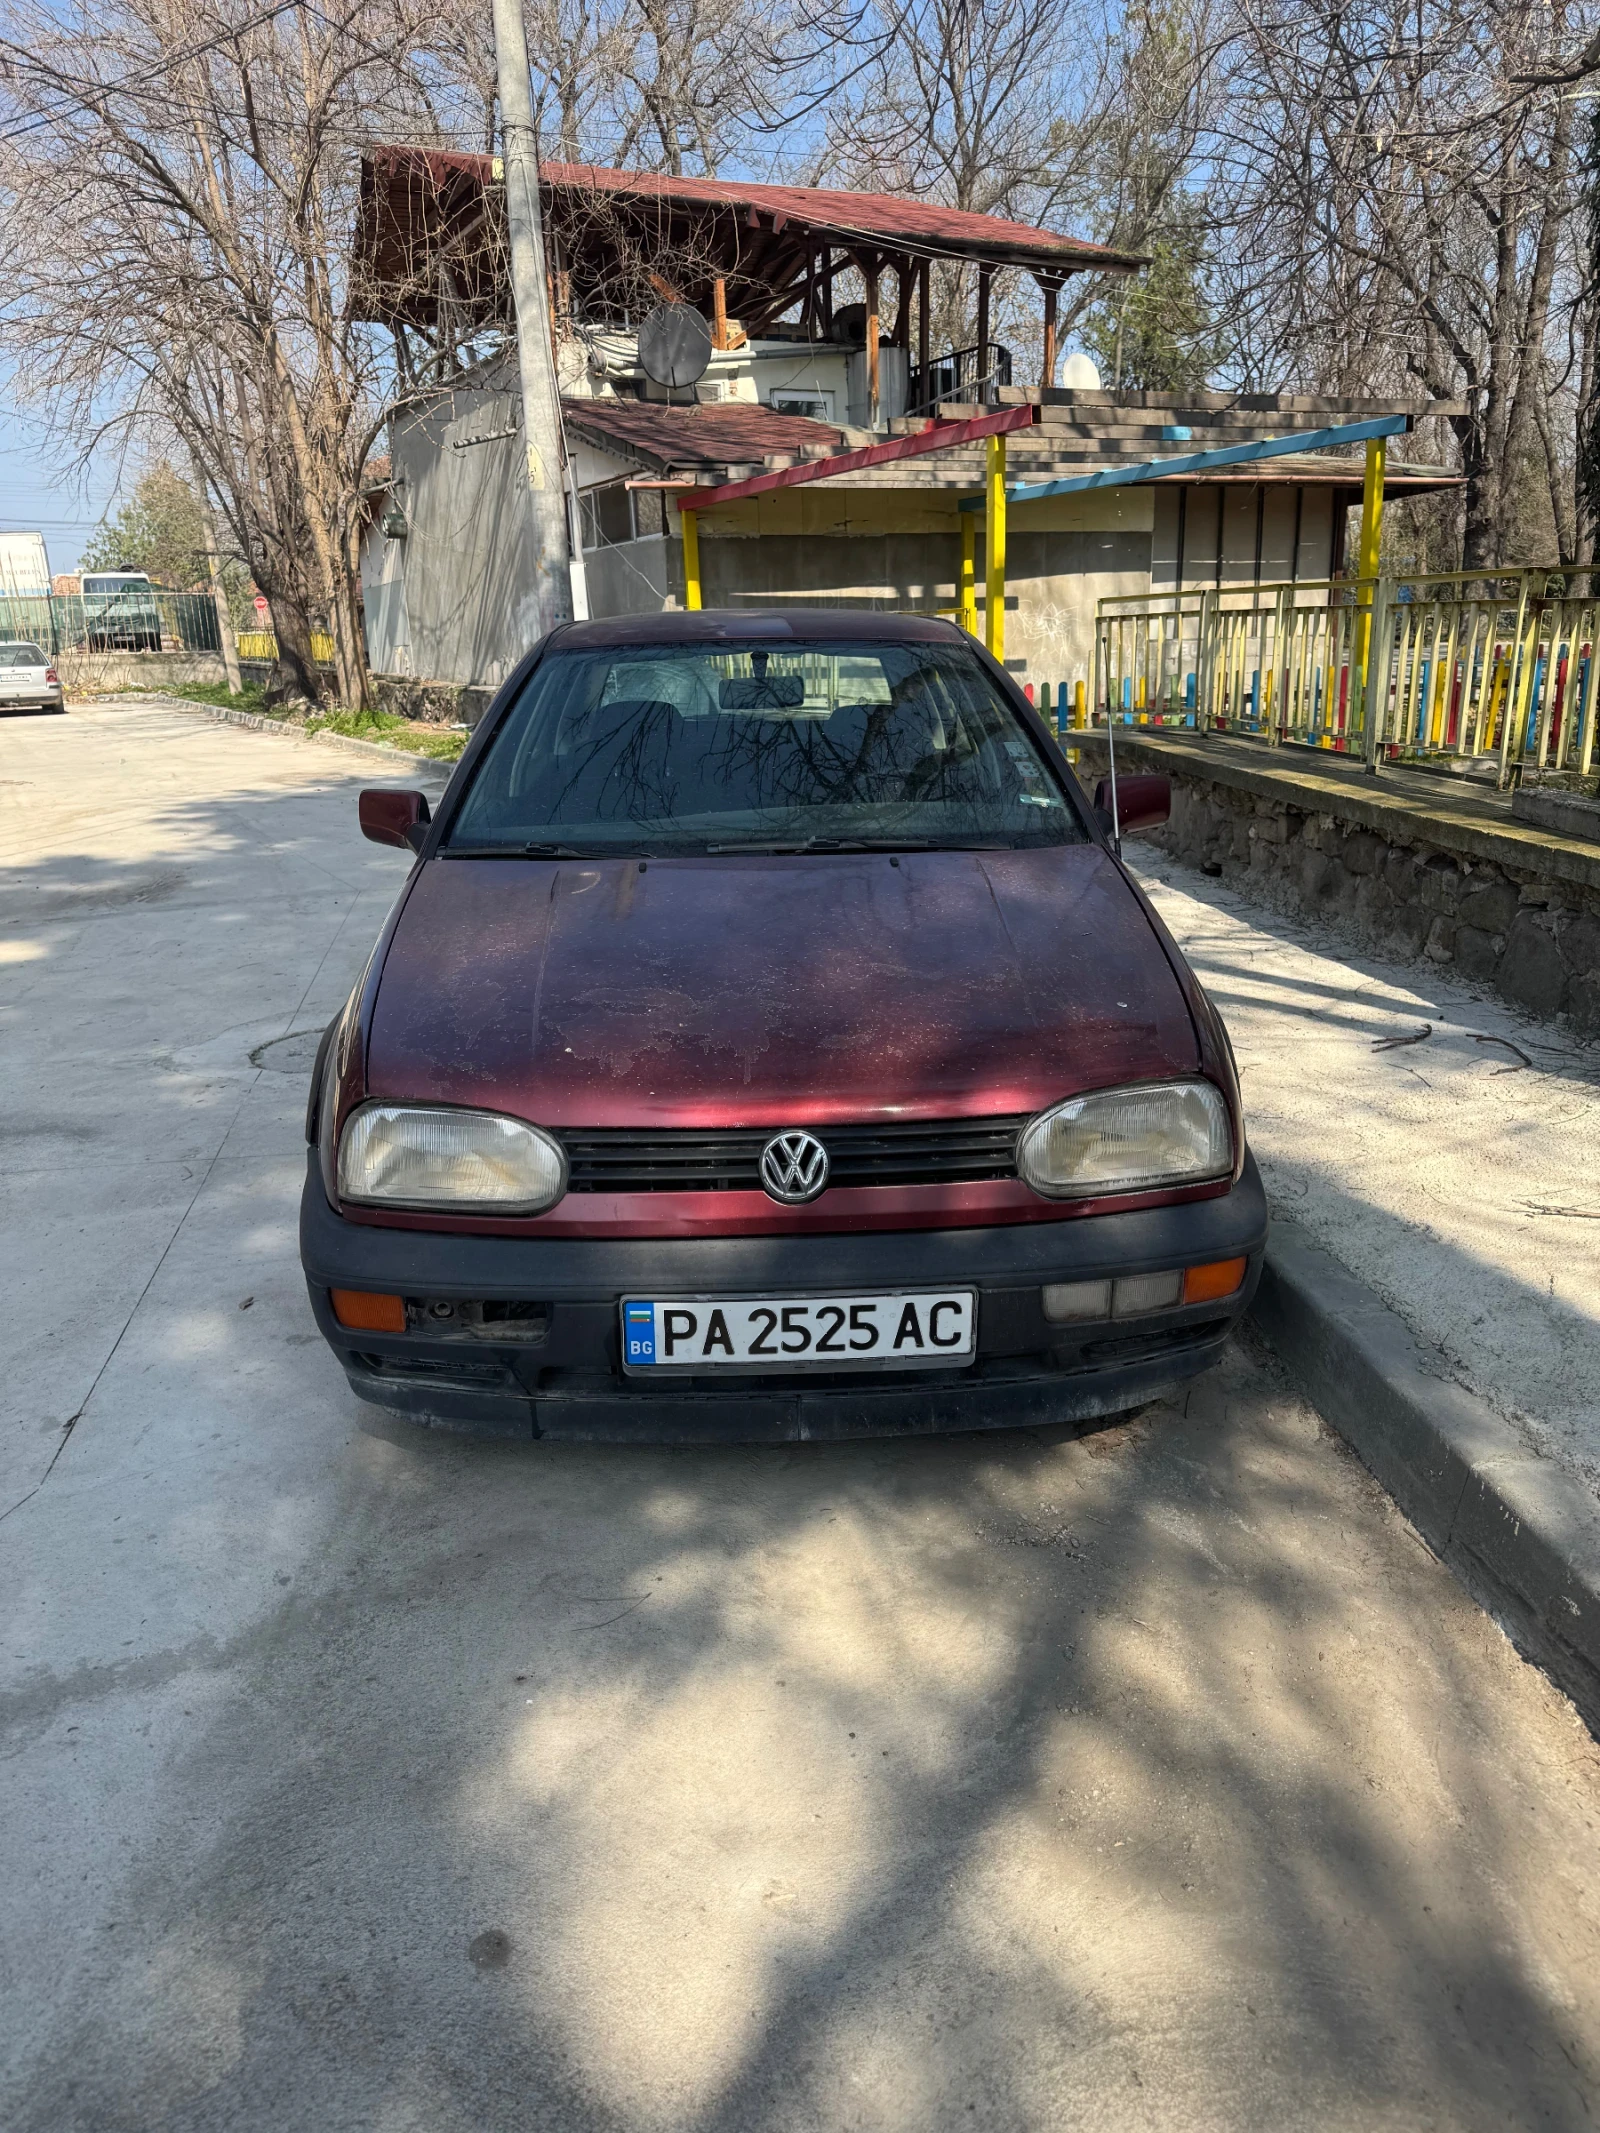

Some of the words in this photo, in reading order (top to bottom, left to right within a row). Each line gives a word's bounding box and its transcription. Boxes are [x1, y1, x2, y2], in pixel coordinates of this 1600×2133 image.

[761, 1132, 829, 1200] VW
[630, 1341, 653, 1355] BG
[663, 1309, 735, 1356] PA
[748, 1304, 879, 1354] 2525
[893, 1300, 962, 1349] AC
